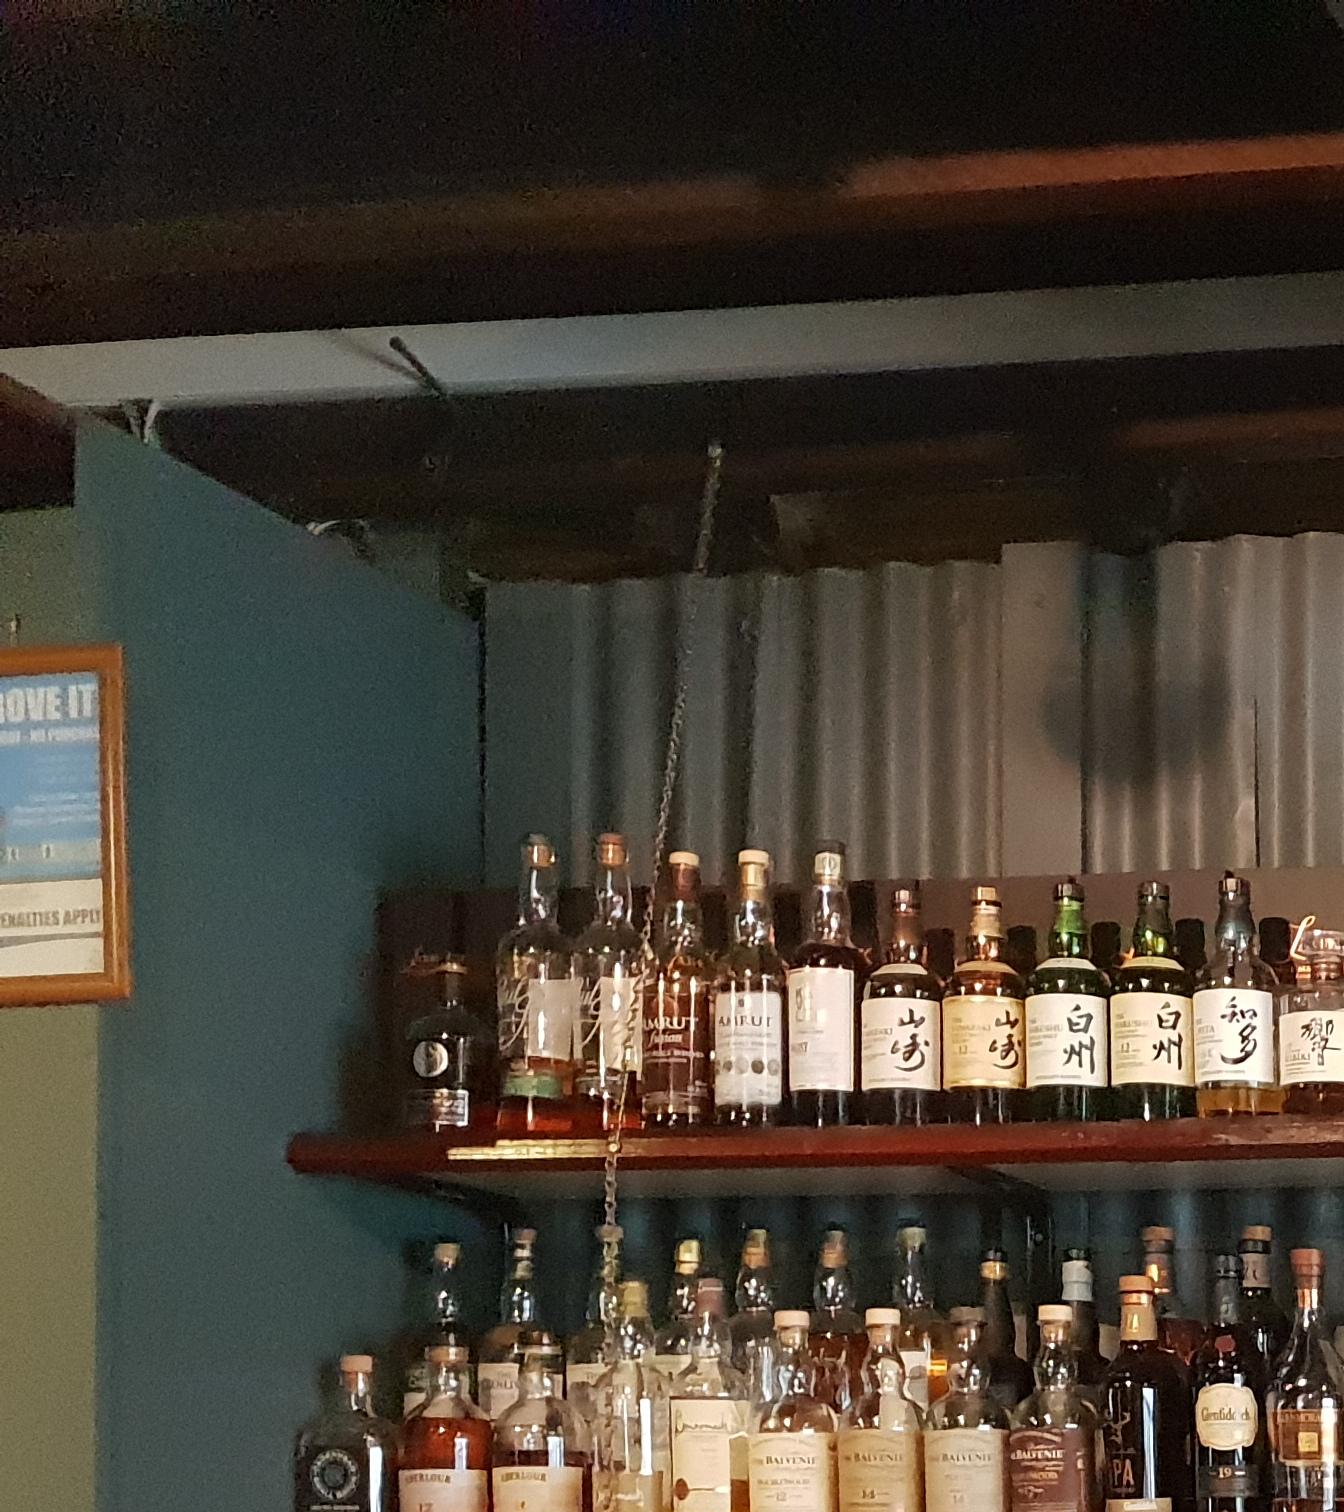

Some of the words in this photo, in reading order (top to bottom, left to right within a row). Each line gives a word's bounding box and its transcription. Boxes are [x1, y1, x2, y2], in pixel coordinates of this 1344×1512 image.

[0, 686, 60, 722] OVE
[0, 911, 59, 928] ENALTIES
[718, 1014, 773, 1028] AMRUT
[1153, 1001, 1183, 1071] 白州
[1062, 1004, 1096, 1075] 白州
